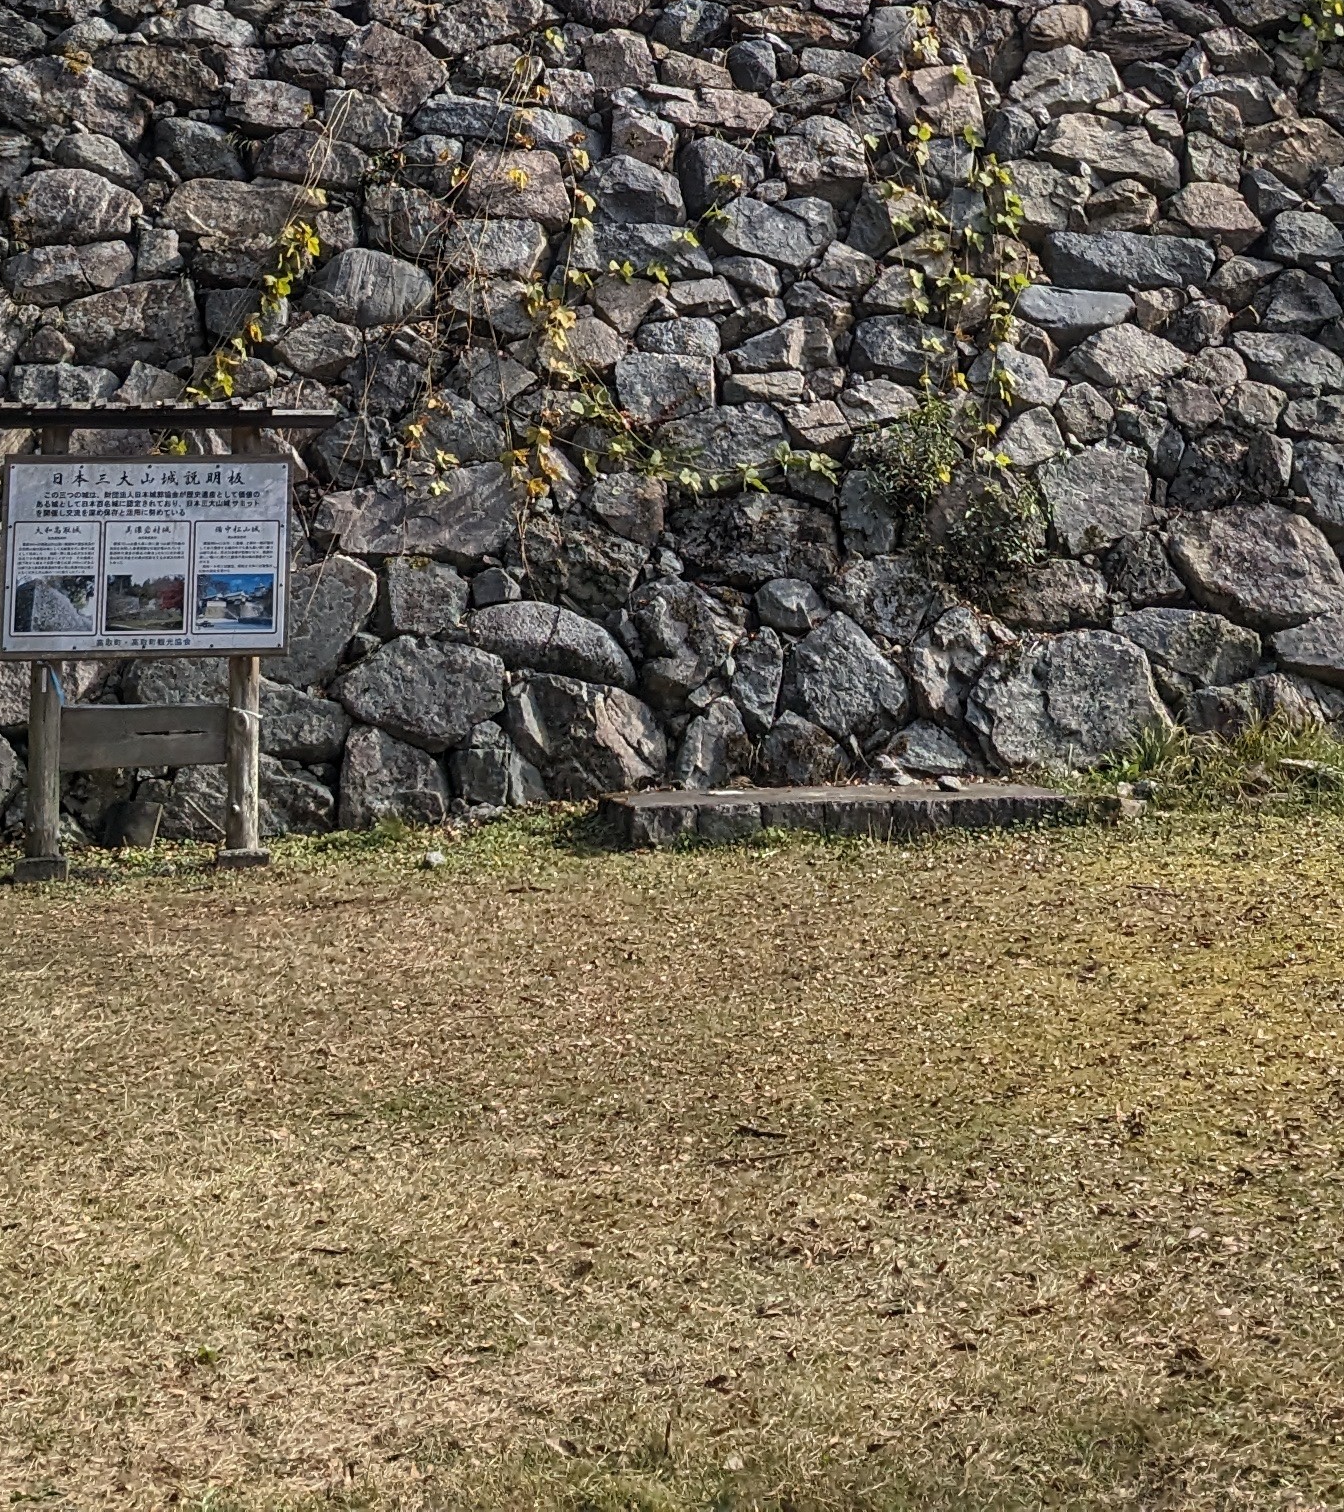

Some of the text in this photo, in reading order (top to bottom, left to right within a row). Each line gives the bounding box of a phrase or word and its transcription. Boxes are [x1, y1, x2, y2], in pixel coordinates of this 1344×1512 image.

[52, 470, 246, 487] 日本三大山城説明板
